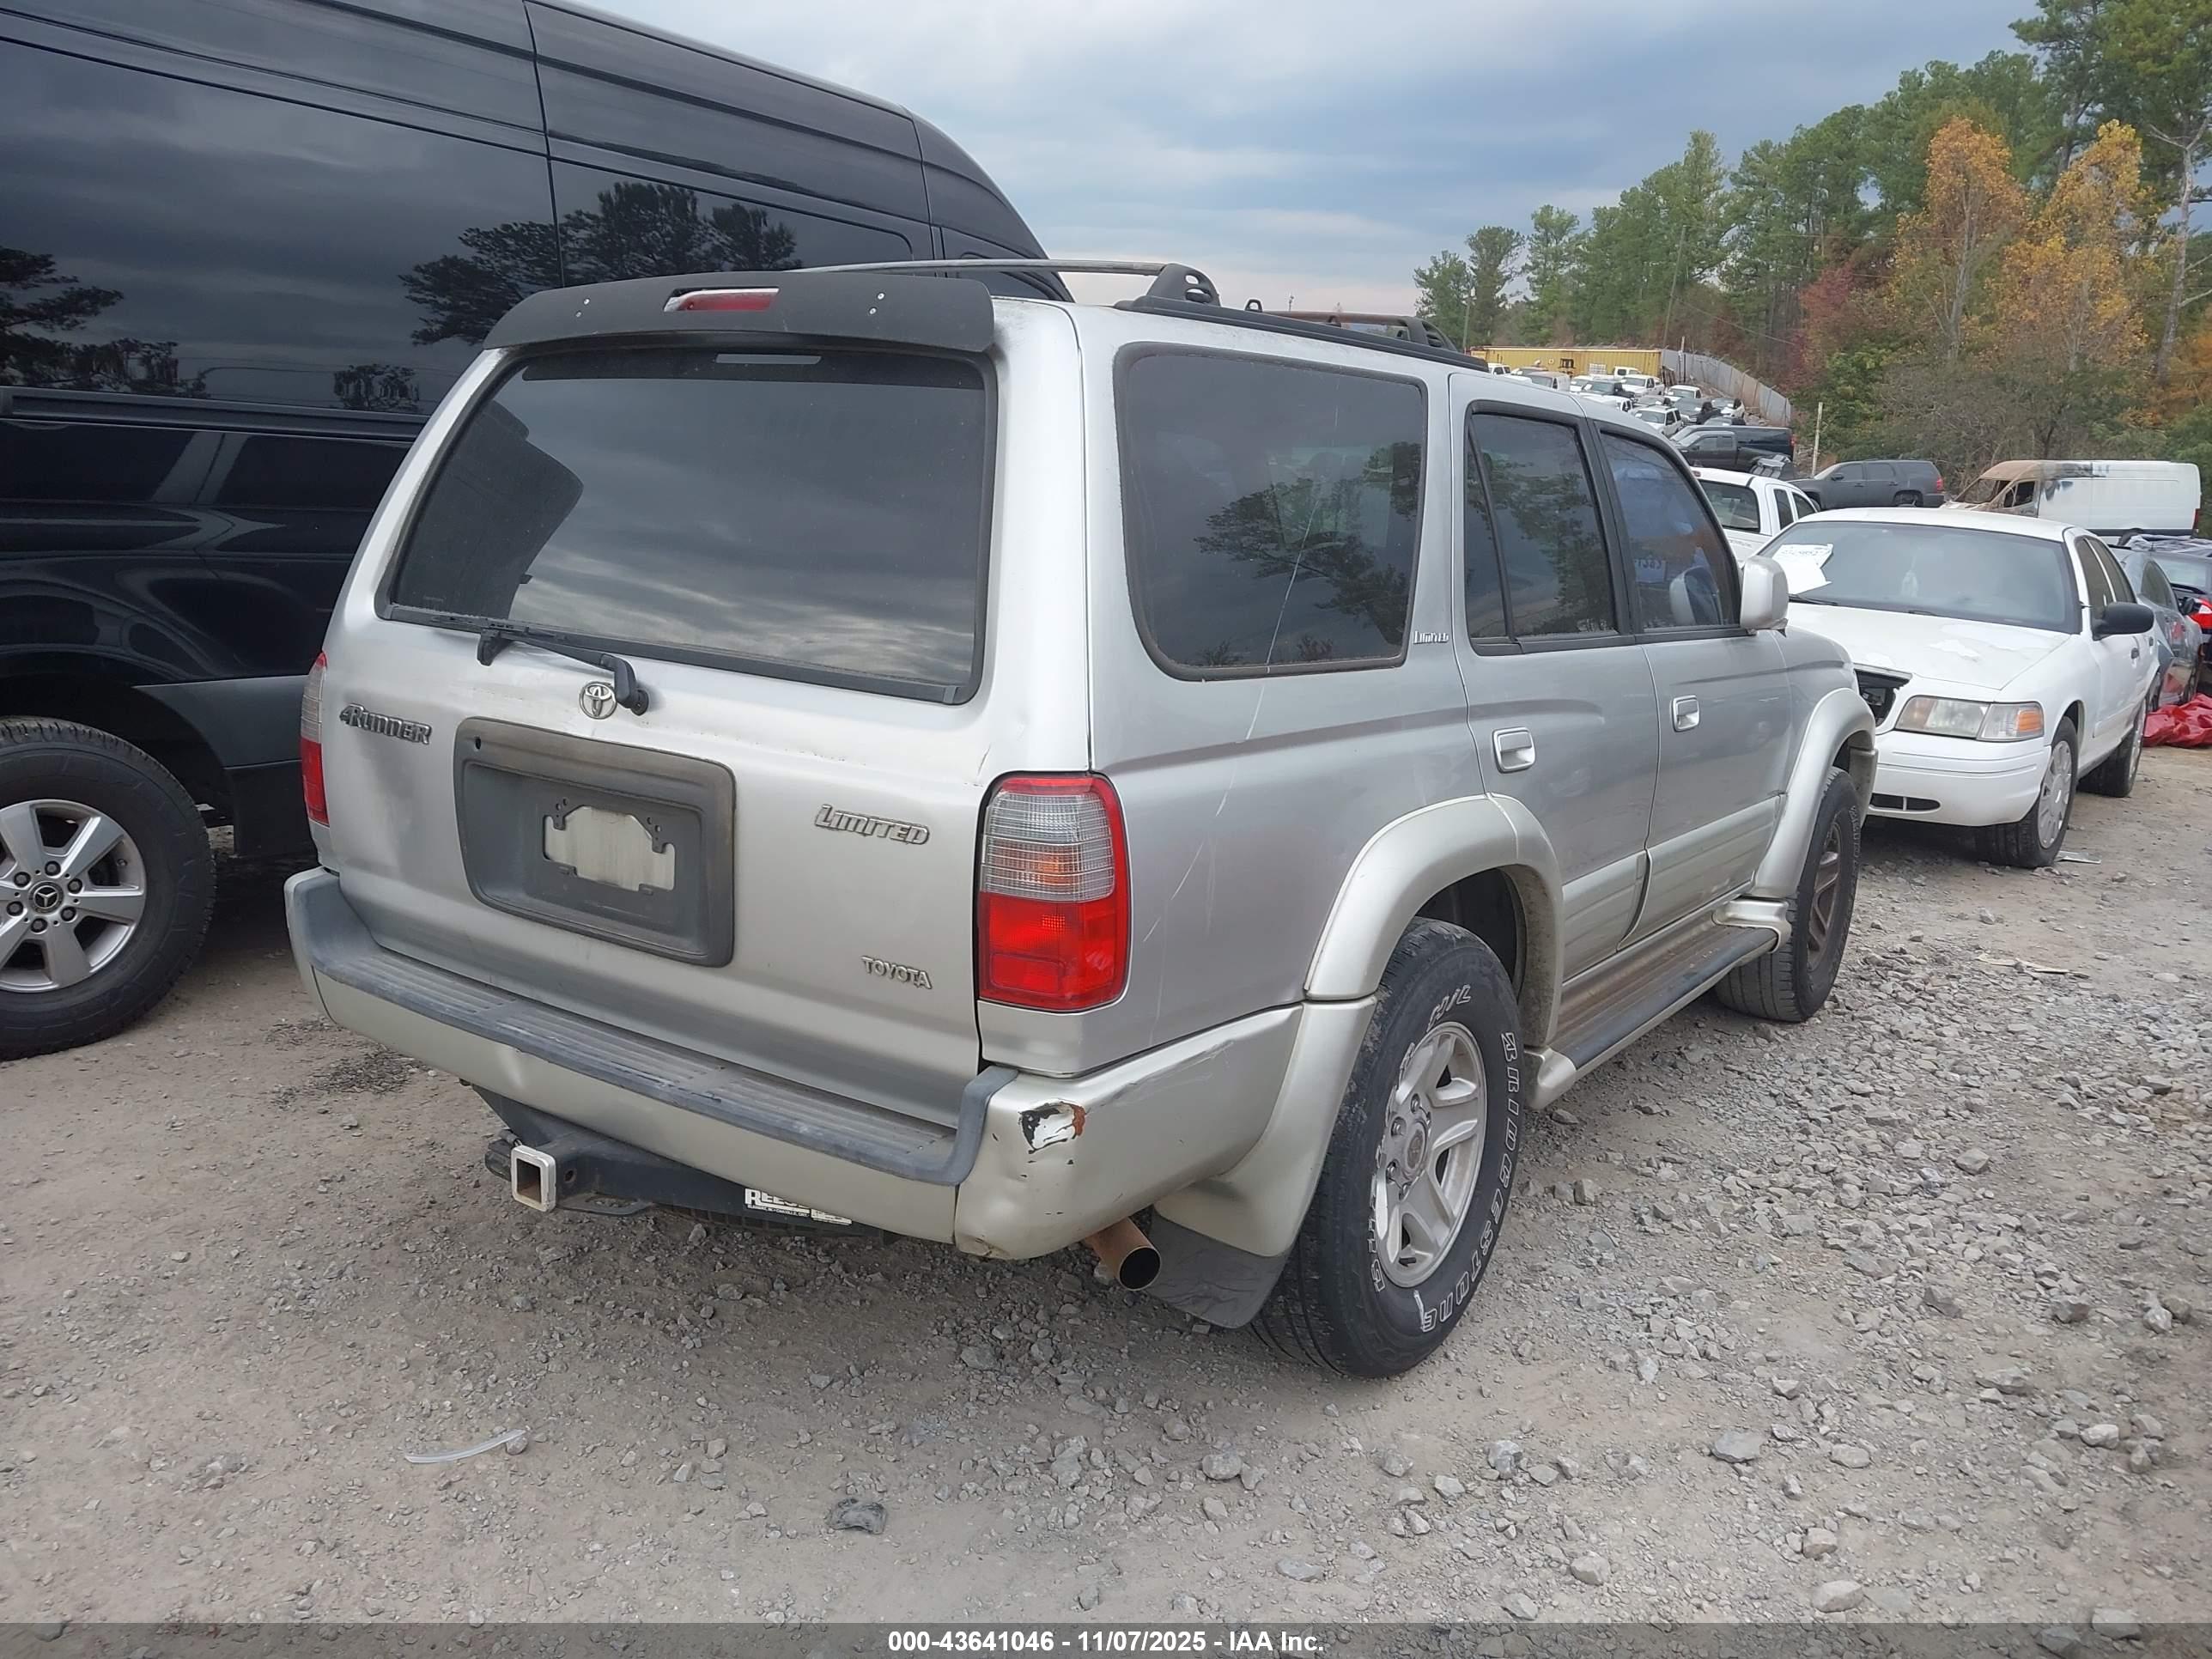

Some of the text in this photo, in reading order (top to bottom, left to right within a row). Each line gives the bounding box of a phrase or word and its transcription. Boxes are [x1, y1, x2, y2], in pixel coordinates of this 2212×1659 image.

[814, 804, 930, 845] LIMITED
[861, 955, 933, 989] TOYOTA
[1419, 1031, 1519, 1333] BRIDGESTONE
